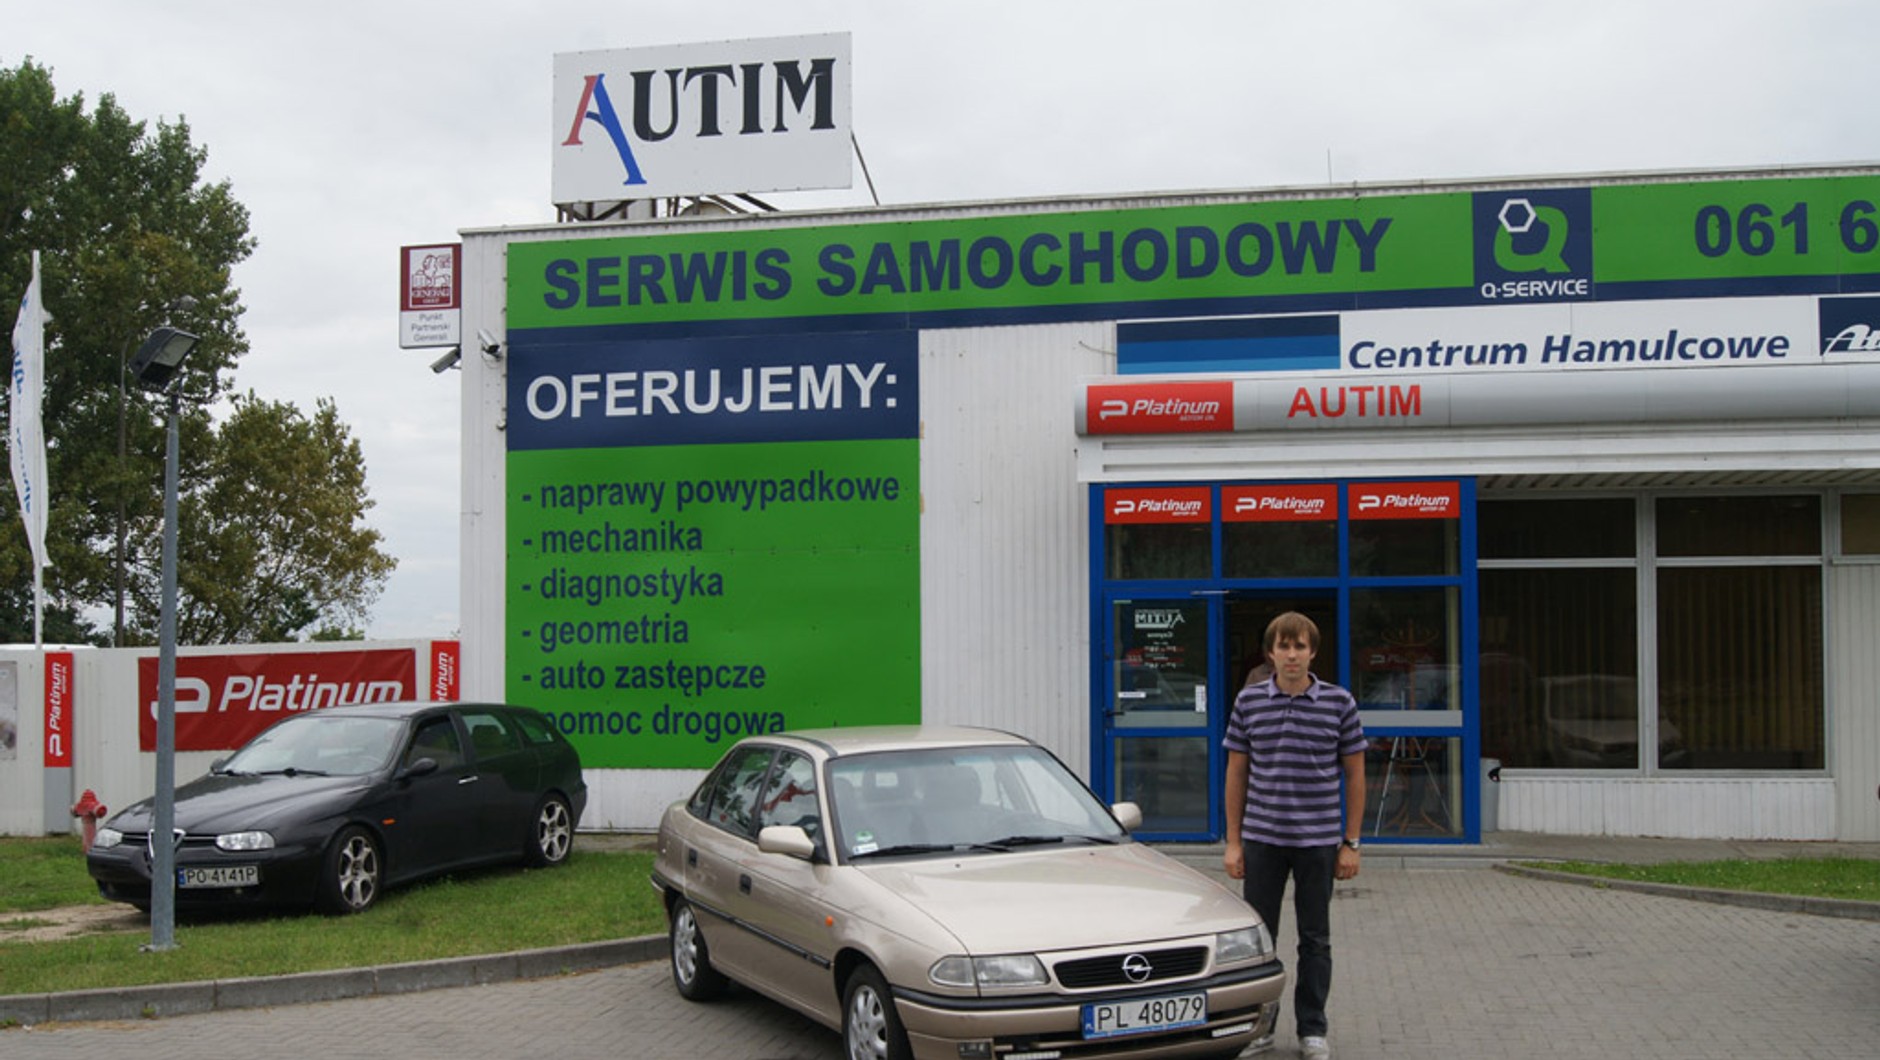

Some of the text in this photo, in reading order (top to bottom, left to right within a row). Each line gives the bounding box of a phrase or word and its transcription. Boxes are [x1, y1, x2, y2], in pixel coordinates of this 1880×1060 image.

[561, 57, 836, 186] AUTIM
[1694, 202, 1809, 257] 061
[543, 217, 1394, 310] SERWIS SAMOCHODOWY
[1480, 279, 1588, 298] Q-SERVICE
[1349, 329, 1790, 370] Centrum Hamulcowe
[526, 362, 897, 421] OFERUJEMY:
[1131, 398, 1220, 416] Platinum
[1287, 384, 1422, 418] AUTIM
[540, 481, 666, 514] naprawy
[676, 470, 900, 512] powypadkowe
[1138, 499, 1202, 513] Platinum
[1259, 496, 1326, 511] Platinum
[1383, 493, 1450, 508] Platinum
[541, 520, 703, 553] mechanika
[540, 566, 724, 606] diagnostyka
[540, 613, 689, 653] geometria
[49, 662, 62, 731] Platinum
[217, 674, 404, 713] Platinum
[540, 660, 606, 689] auto
[615, 659, 767, 697] zastępcze
[652, 703, 786, 744] drogowa
[1097, 995, 1204, 1031] PL 48079
